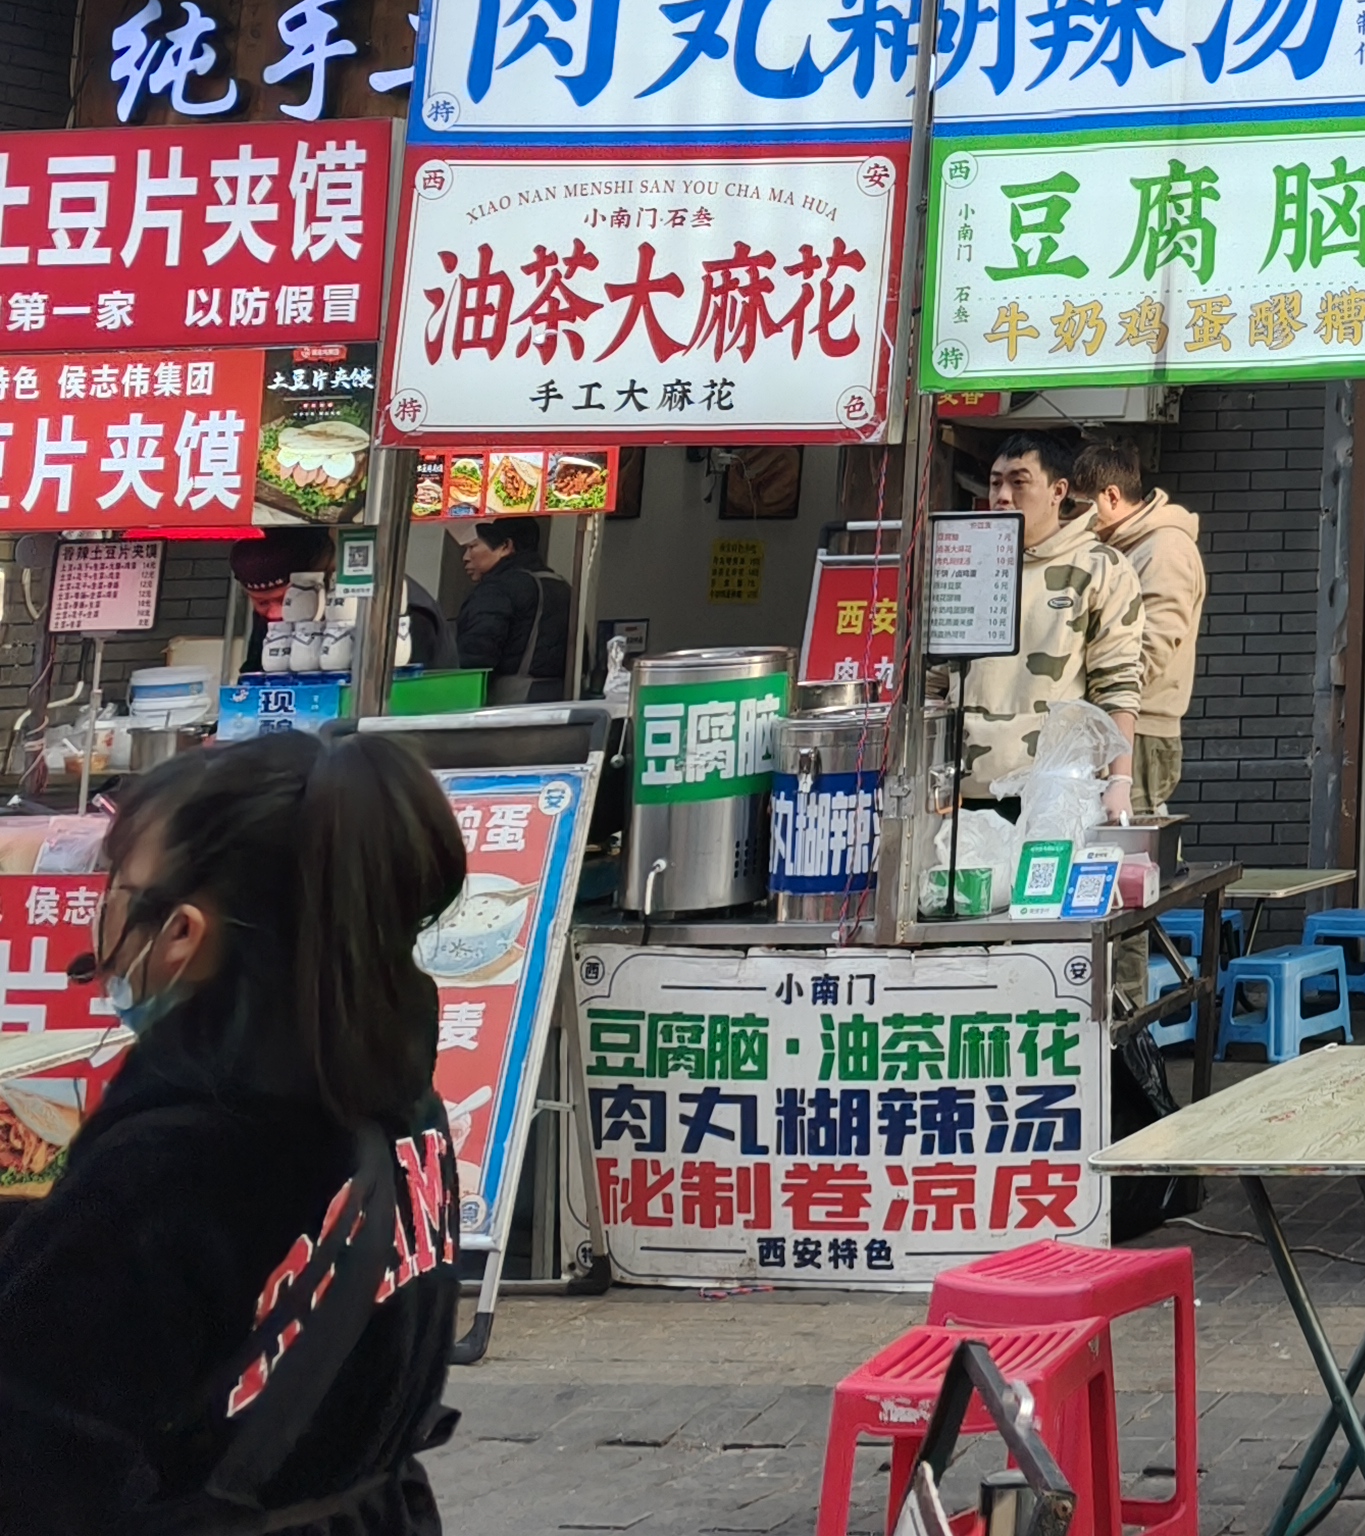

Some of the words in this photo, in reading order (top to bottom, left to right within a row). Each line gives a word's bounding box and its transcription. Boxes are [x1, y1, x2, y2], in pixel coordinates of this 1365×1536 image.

[427, 98, 455, 123] 特
[422, 170, 446, 192] 西
[864, 164, 890, 188] 安
[949, 160, 971, 180] 西
[466, 195, 512, 224] XIAO
[518, 184, 558, 206] NAN
[563, 178, 634, 198] MENSHI
[640, 178, 676, 194] SAN
[682, 178, 719, 196] YOU
[725, 181, 761, 199] CHA
[768, 187, 795, 206] MA
[802, 194, 839, 222] HUA
[956, 204, 975, 263] 小南门
[0, 291, 135, 332] 第一家
[184, 283, 361, 328] 以防假冒
[424, 237, 866, 366] 油茶大麻花
[938, 345, 964, 370] 特
[58, 361, 215, 400] 侯志伟集团
[529, 378, 736, 412] 手工大麻花
[394, 396, 422, 420] 特
[843, 396, 869, 421] 色
[0, 410, 244, 512] 片夹馍
[836, 598, 897, 635] 西安
[641, 693, 780, 786] 豆腐脑
[584, 962, 601, 981] 西
[1068, 962, 1088, 981] 安
[774, 973, 878, 1005] 小南门
[586, 1009, 1081, 1082] 豆腐脑·油茶麻花
[588, 1084, 1082, 1156] 肉丸糊辣汤
[595, 1158, 1081, 1231] 秘制卷凉皮
[757, 1237, 896, 1270] 西安特色
